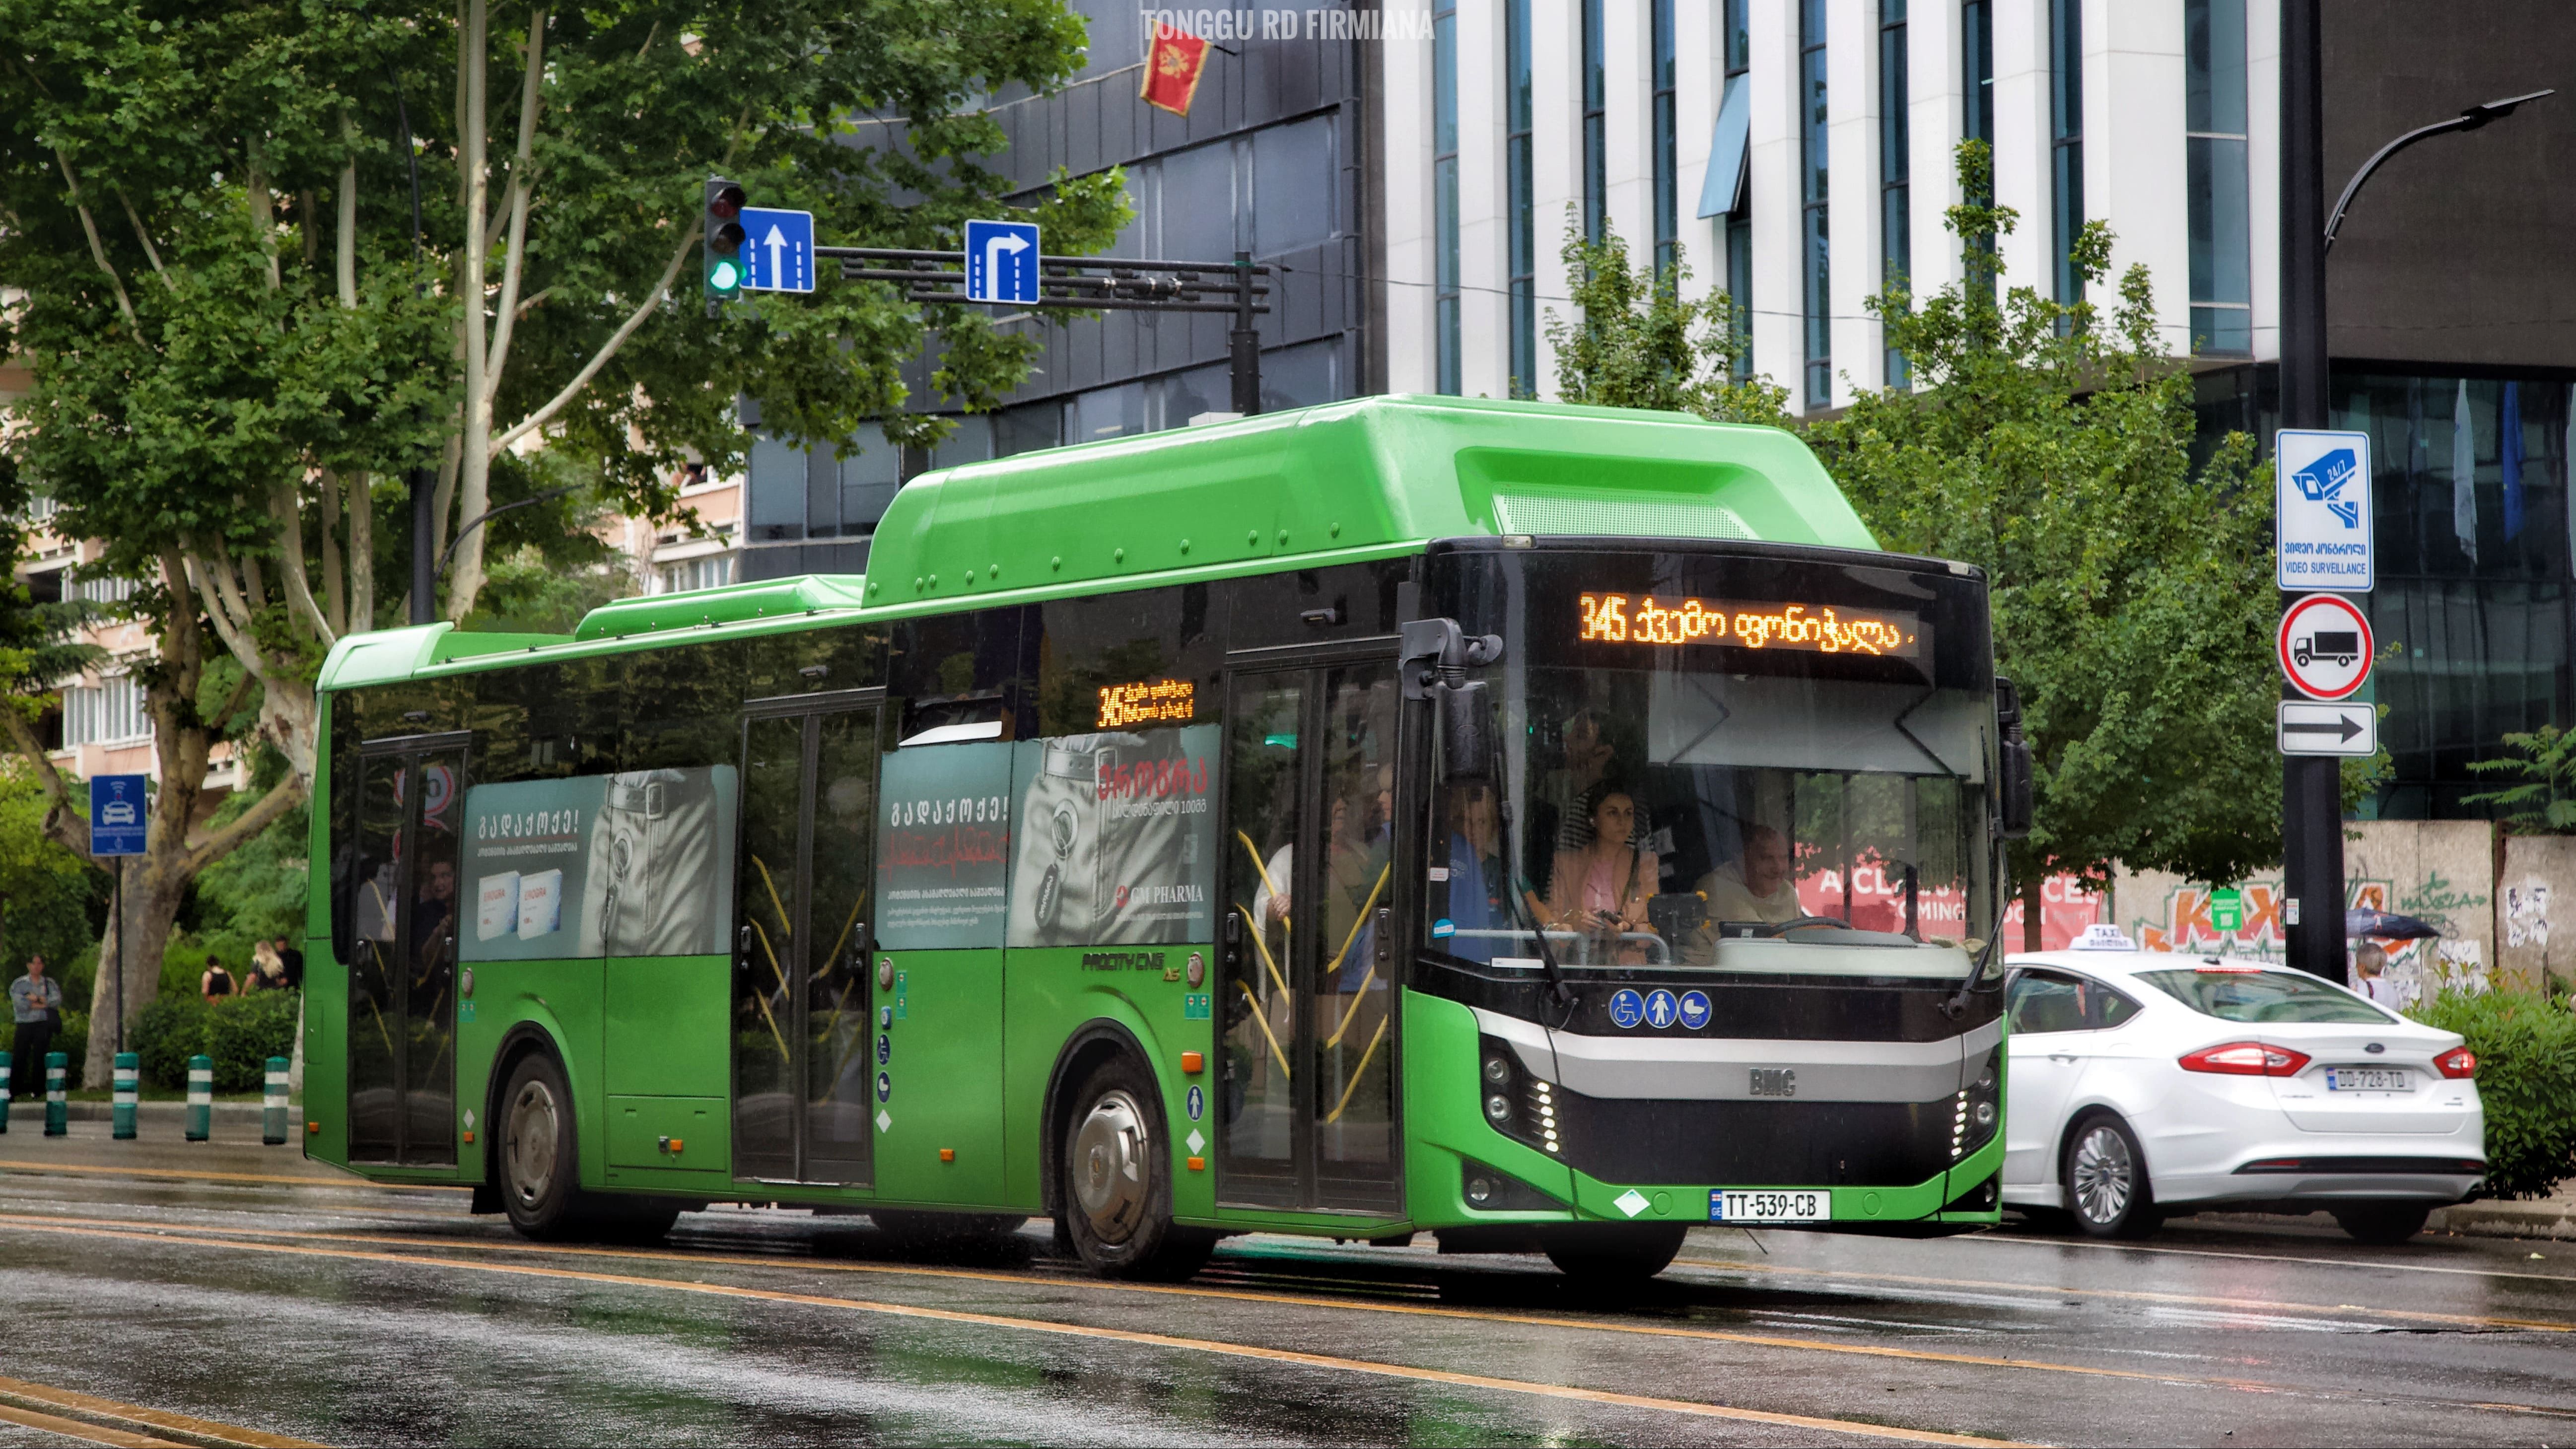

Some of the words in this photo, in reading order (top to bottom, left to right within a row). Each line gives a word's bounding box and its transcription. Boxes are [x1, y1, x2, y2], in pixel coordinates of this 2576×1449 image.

[2327, 460, 2346, 482] 24/7
[2285, 542, 2313, 555] ვიდეო
[2316, 544, 2366, 555] კონტროლი
[2286, 562, 2308, 573] VIDEO
[2311, 563, 2366, 574] SURVEILLANCE
[1581, 596, 1626, 640] 345
[1633, 598, 1726, 643] ქვემო
[1099, 687, 1125, 727] 345
[1097, 756, 1208, 801] ეროგრა
[1154, 885, 1204, 903] PHARMA
[2095, 928, 2120, 937] TAXI
[1136, 952, 1165, 970] CNG
[1749, 1067, 1796, 1096] BMC
[1726, 1194, 1816, 1217] TT-539-CB
